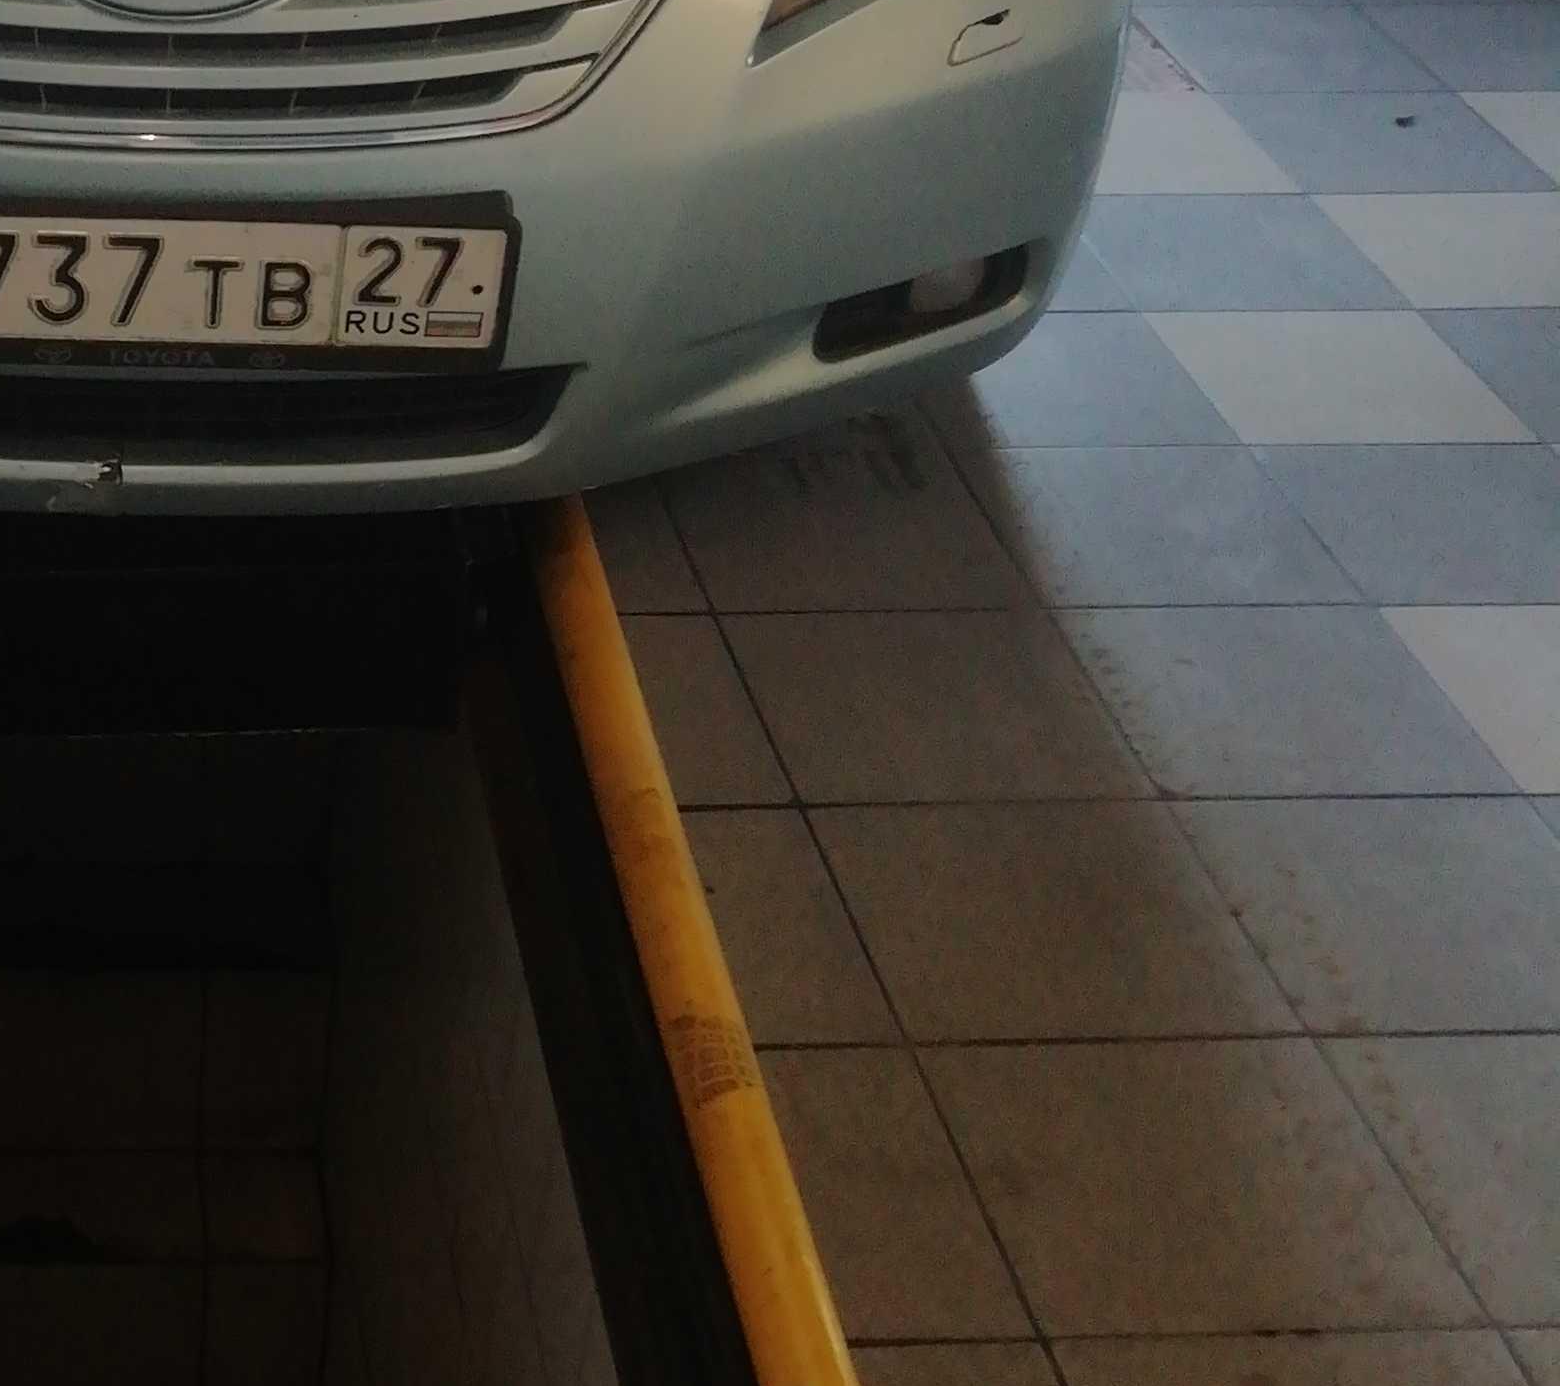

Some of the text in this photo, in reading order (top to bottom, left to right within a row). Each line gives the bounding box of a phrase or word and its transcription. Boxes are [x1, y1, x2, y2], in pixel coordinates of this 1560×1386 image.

[357, 237, 463, 307] 27
[345, 310, 420, 336] RUS
[107, 348, 216, 368] TOYOTA
